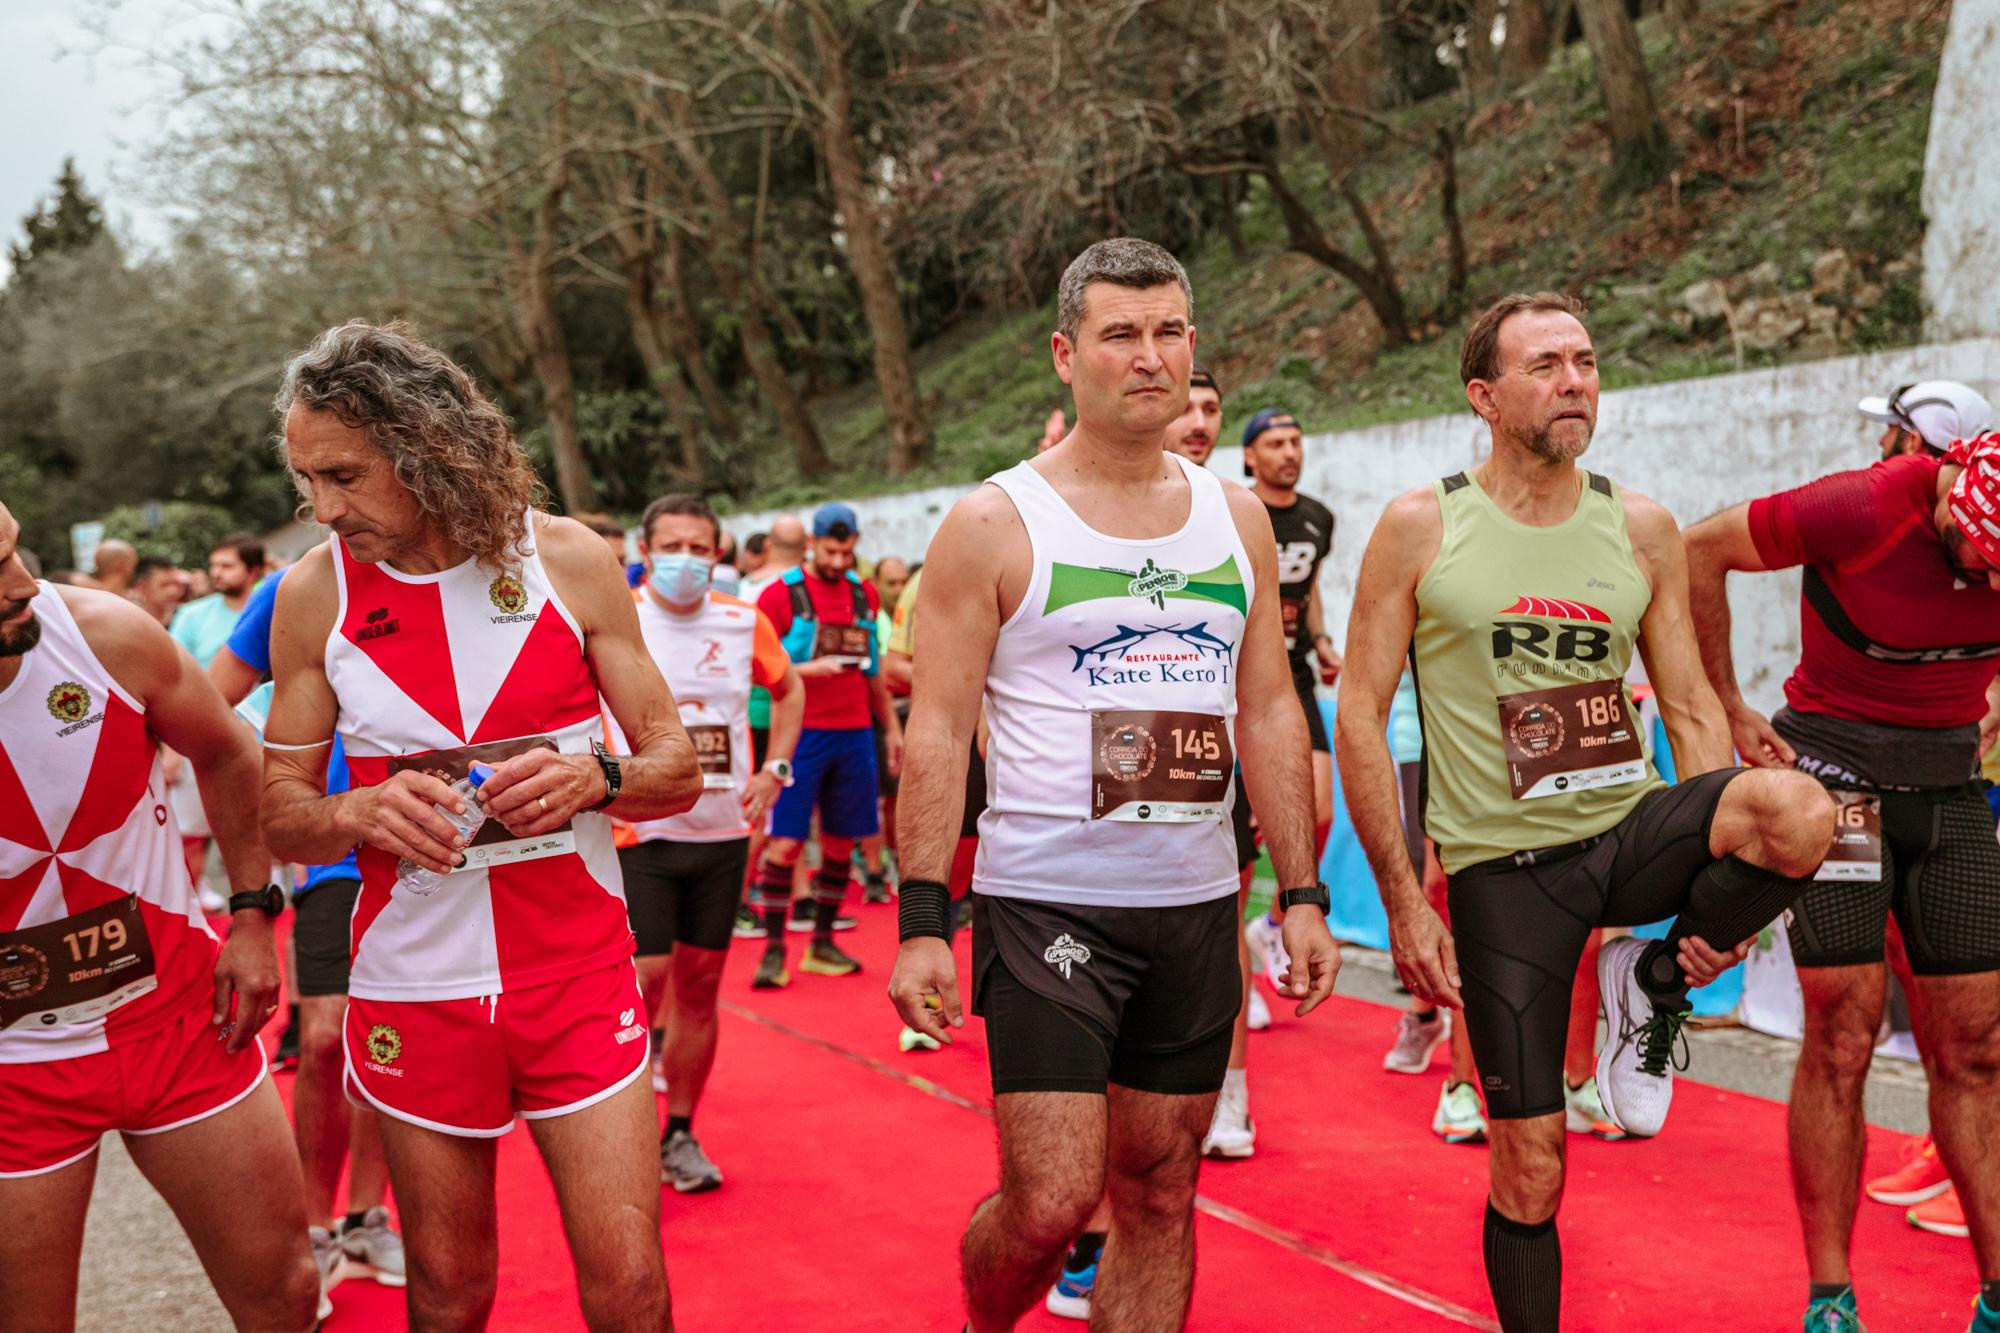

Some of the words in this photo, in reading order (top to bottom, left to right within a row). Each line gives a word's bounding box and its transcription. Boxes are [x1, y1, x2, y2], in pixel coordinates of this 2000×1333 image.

[490, 613, 538, 625] VIEIRENSE
[1492, 621, 1611, 662] RB
[1126, 653, 1200, 663] RESTAURANTE
[1087, 666, 1151, 687] Kate
[1158, 662, 1216, 683] Kero
[1576, 693, 1620, 728] 186
[56, 711, 104, 738] VIEIRENSE
[693, 730, 726, 753] 192
[1171, 728, 1220, 760] 145
[1580, 735, 1607, 748] 10km
[1169, 768, 1196, 780] 10km
[1836, 803, 1865, 828] 16
[63, 917, 128, 962] 179
[68, 967, 103, 983] 10km
